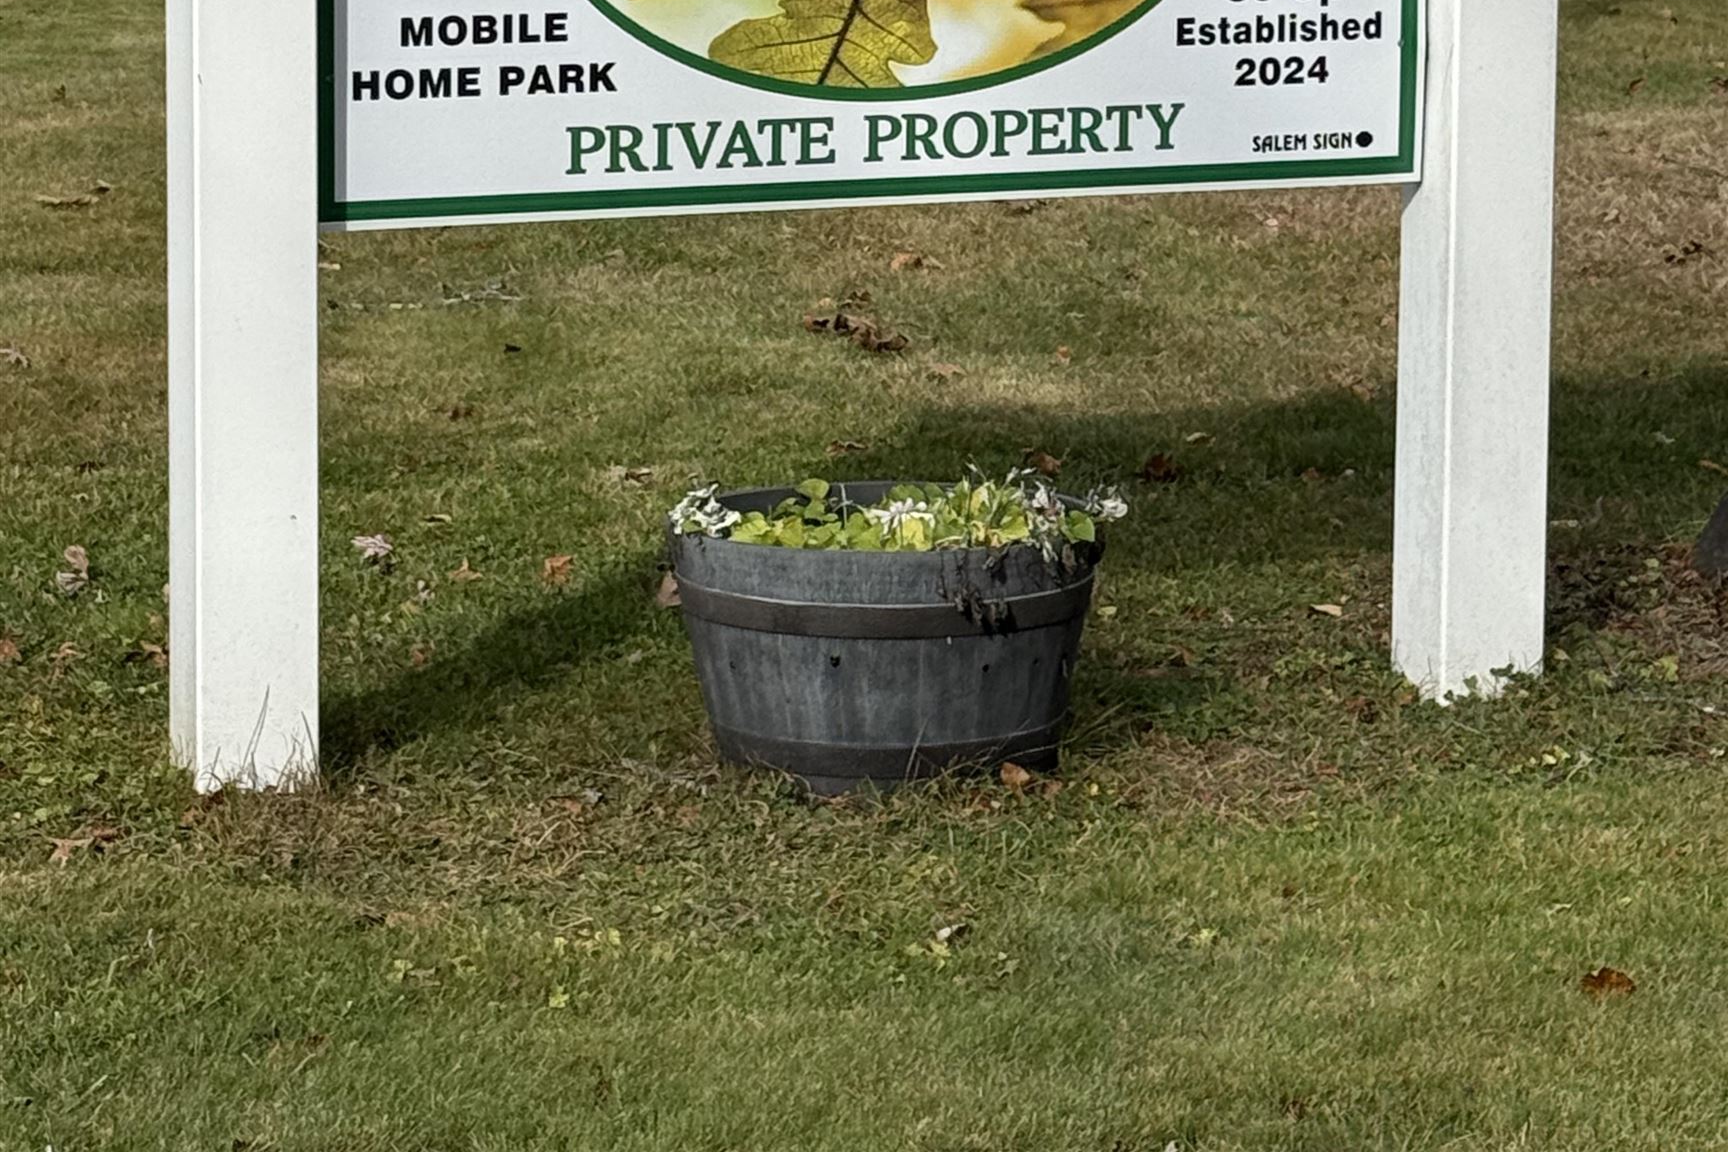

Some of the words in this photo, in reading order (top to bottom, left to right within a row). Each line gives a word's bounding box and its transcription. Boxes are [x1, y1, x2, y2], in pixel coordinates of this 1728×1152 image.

[400, 13, 568, 47] MOBILE
[1176, 11, 1383, 46] Established
[352, 67, 481, 101] HOME
[499, 62, 617, 95] PARK
[1234, 56, 1329, 87] 2024
[565, 116, 836, 175] PRIVATE
[863, 103, 1185, 163] PROPERTY
[1252, 133, 1307, 153] SALEM
[1313, 131, 1352, 150] SIGN
